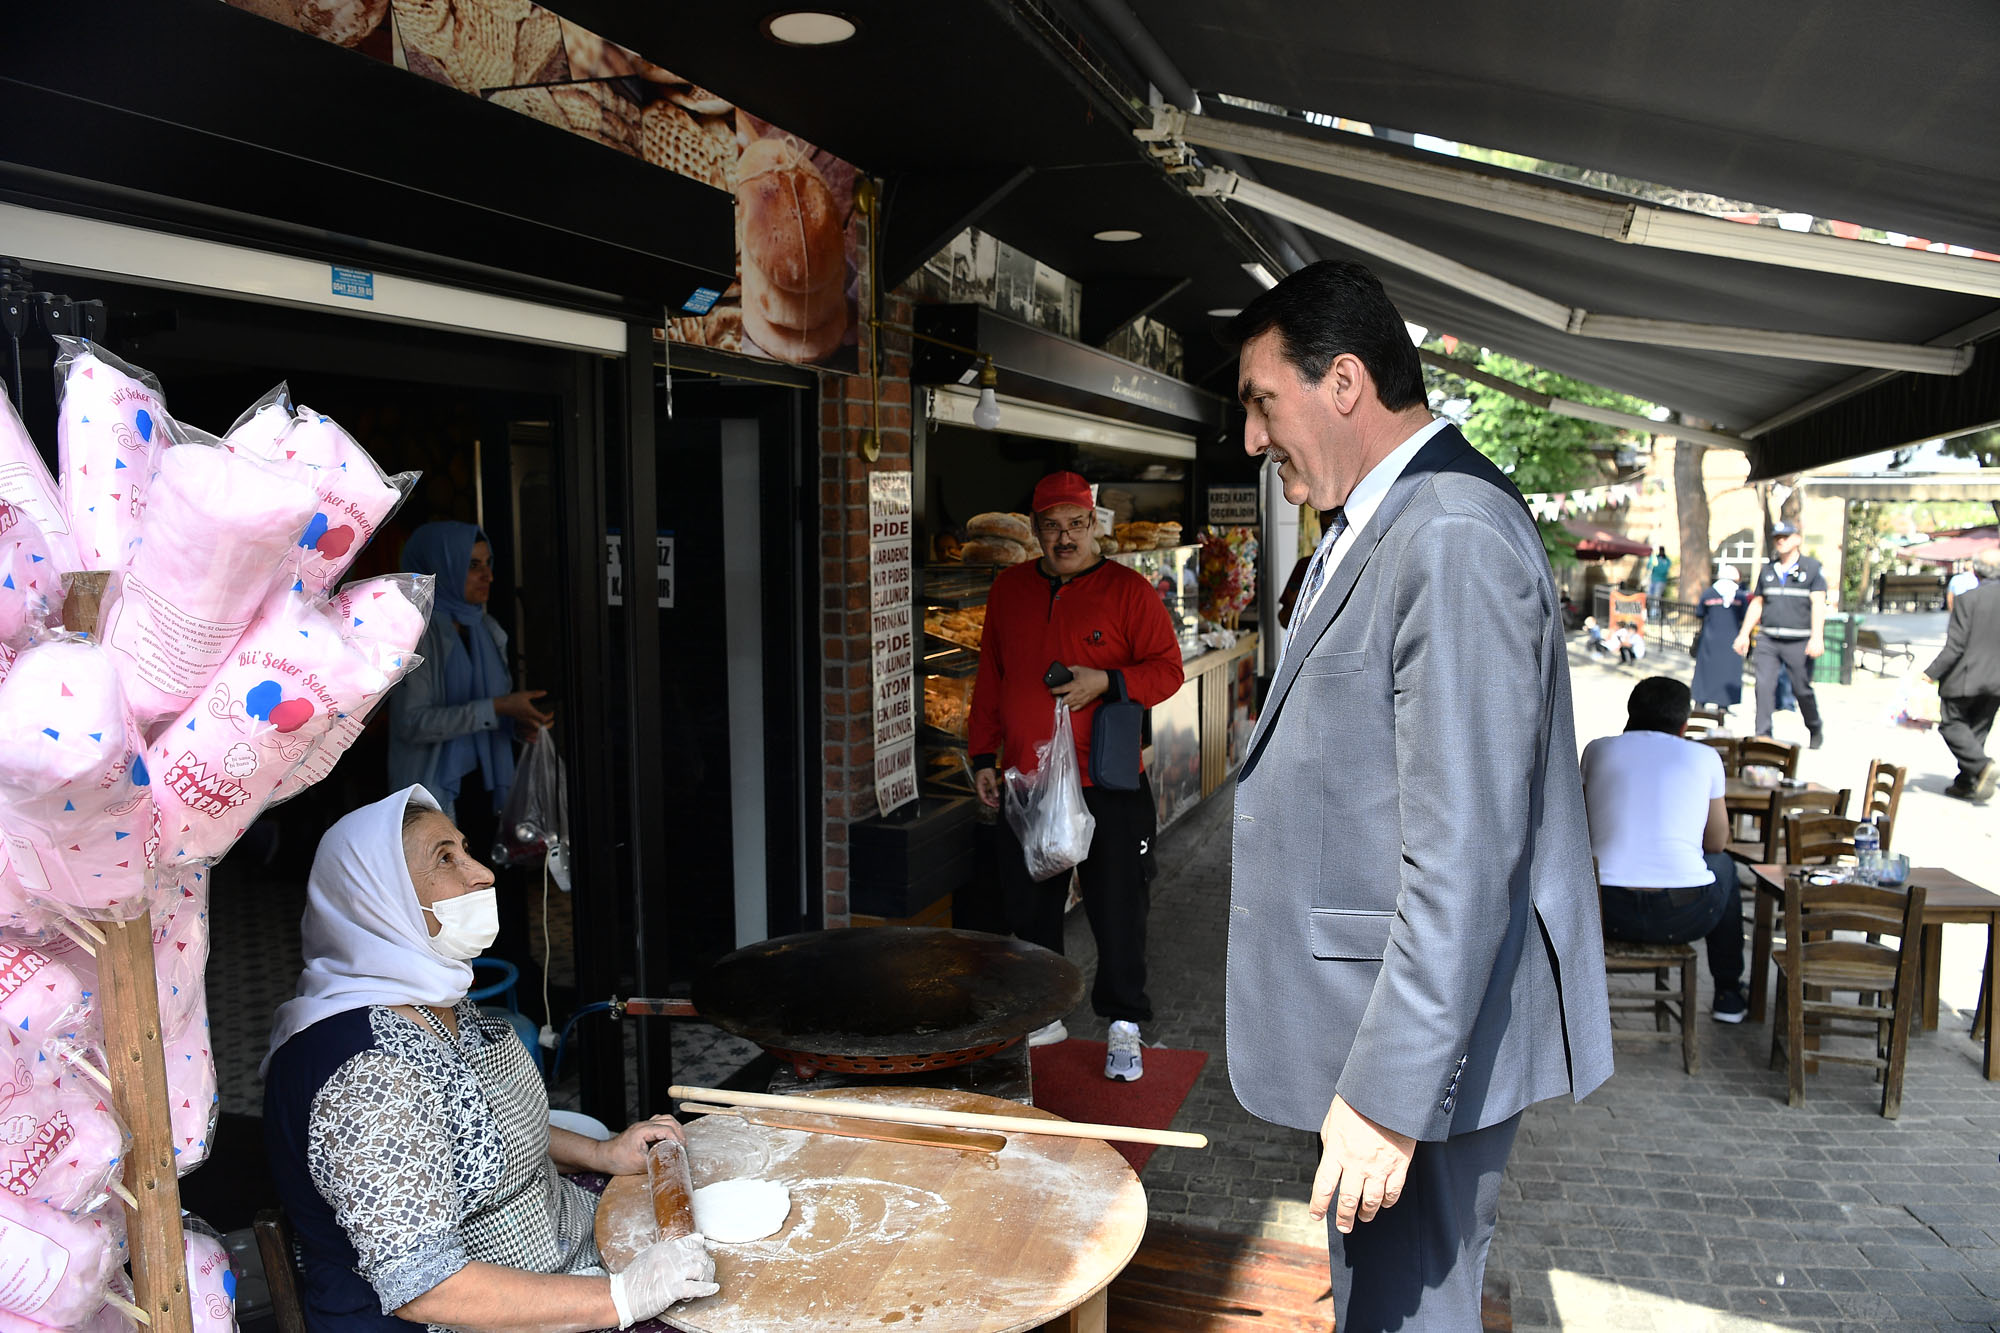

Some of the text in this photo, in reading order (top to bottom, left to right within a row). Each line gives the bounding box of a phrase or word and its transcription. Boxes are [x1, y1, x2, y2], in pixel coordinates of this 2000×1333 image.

[873, 518, 909, 538] PİDE
[874, 586, 910, 608] BULUNUR
[875, 632, 911, 656] PİDE
[262, 651, 302, 678] Şeker
[878, 676, 911, 700] ATOM
[877, 717, 912, 744] BULUNUR
[175, 751, 251, 806] PAMUK
[164, 766, 235, 819] ŞEKERİ
[0, 1110, 68, 1189] PAMUK
